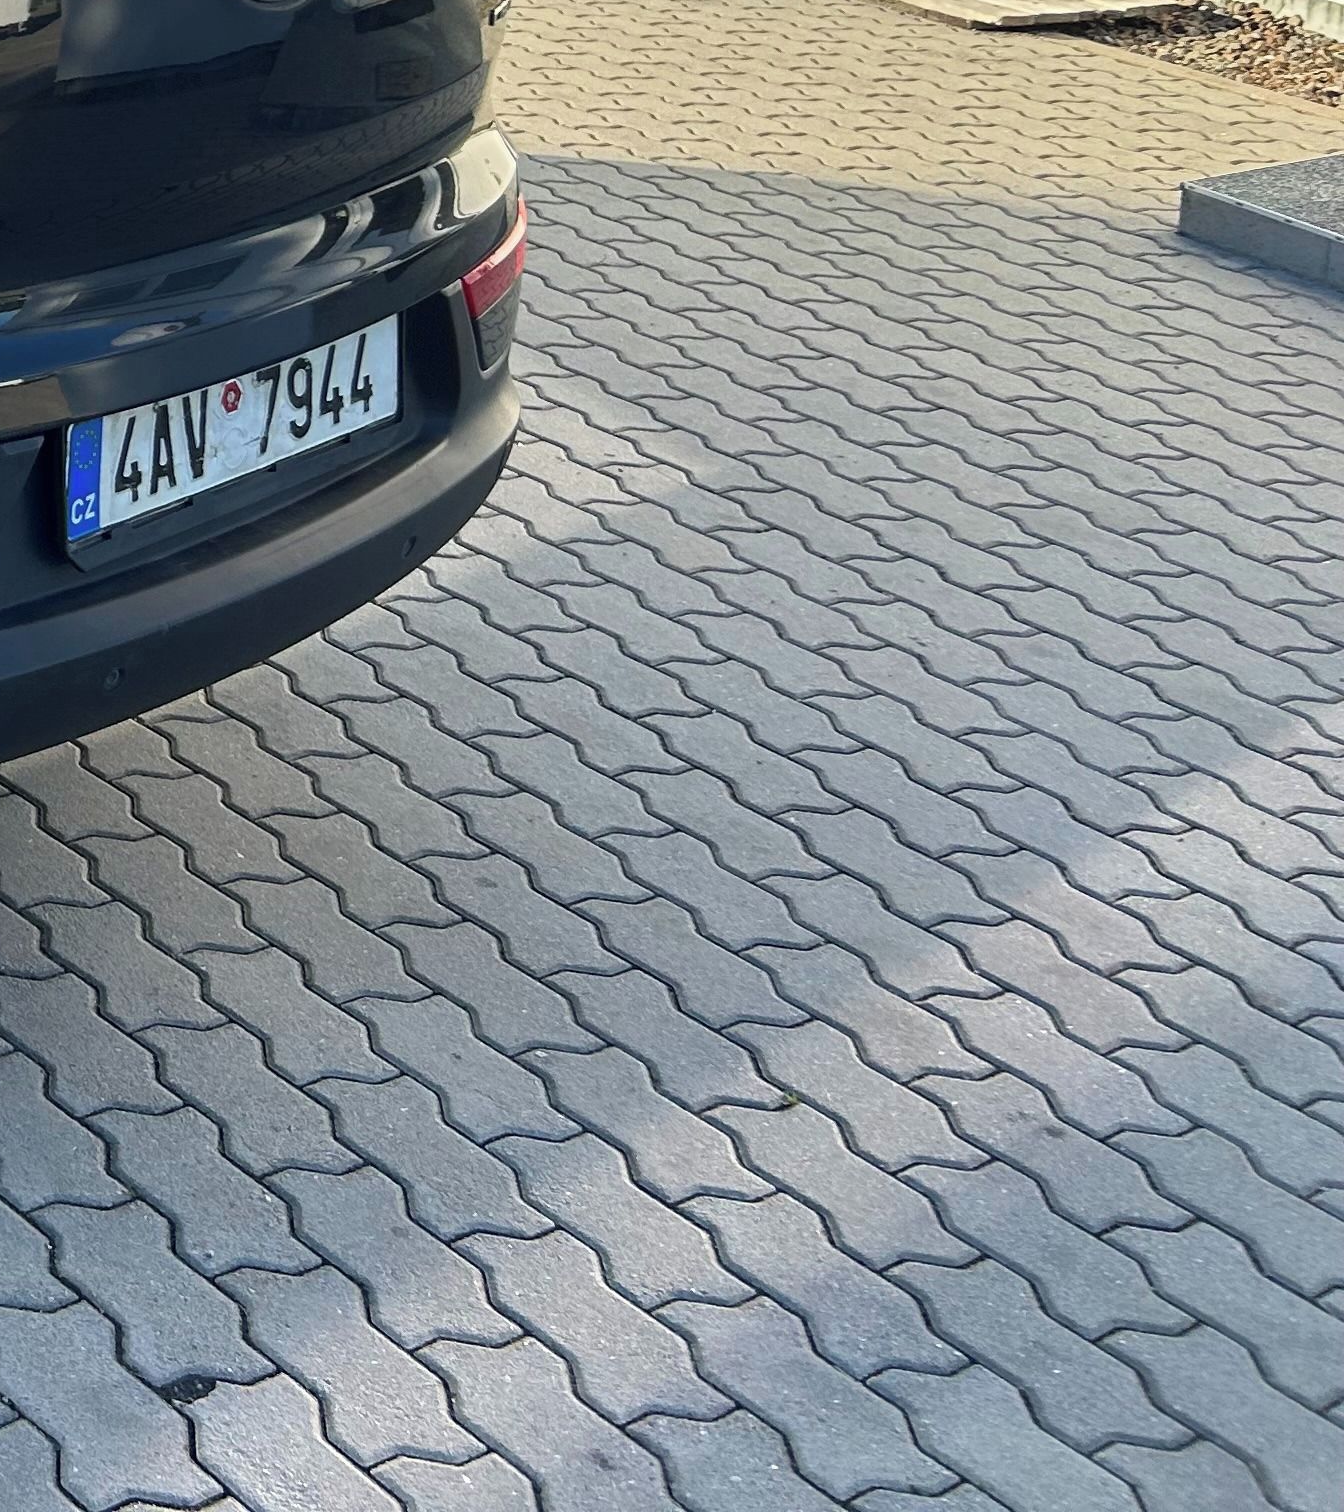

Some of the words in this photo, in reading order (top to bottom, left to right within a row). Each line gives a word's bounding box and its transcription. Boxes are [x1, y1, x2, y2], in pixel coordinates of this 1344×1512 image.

[114, 389, 208, 502] 4AV
[256, 333, 373, 455] 7944
[71, 492, 96, 524] CZ
